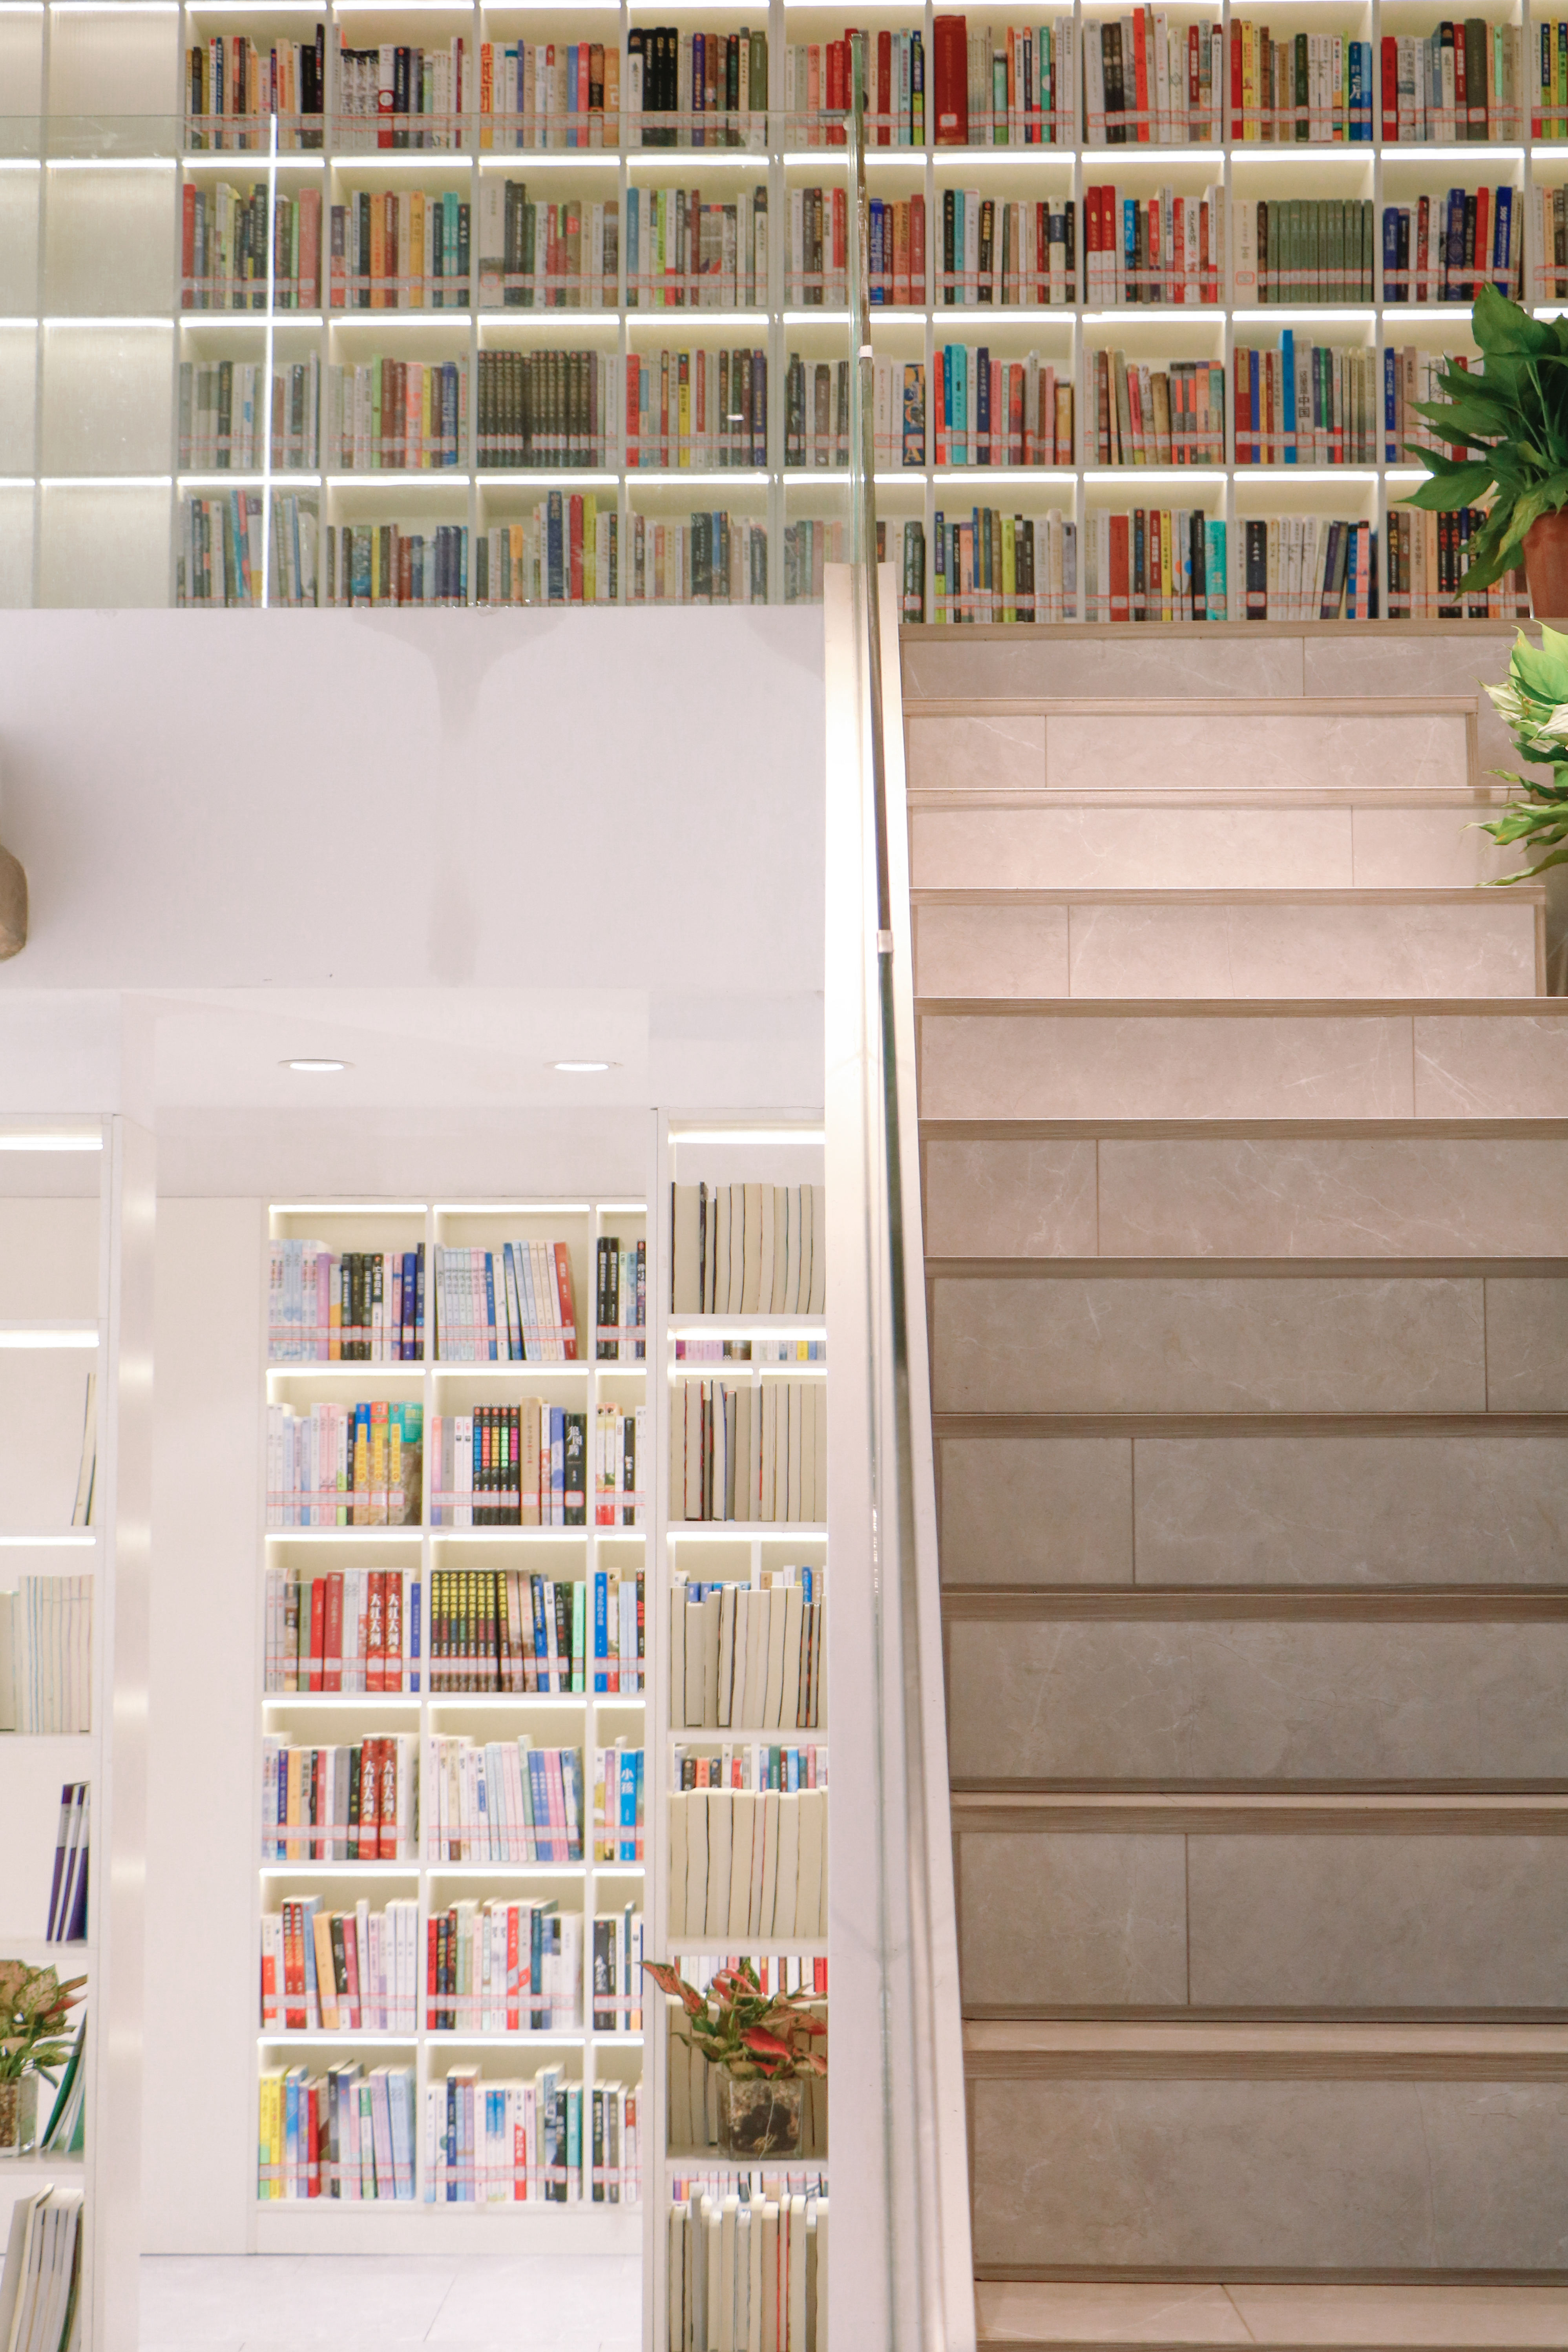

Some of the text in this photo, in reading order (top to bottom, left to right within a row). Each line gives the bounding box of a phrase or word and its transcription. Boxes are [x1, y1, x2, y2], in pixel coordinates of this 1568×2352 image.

[1298, 370, 1310, 418] 这里是中国
[566, 1425, 583, 1457] 狼图腾
[369, 1593, 382, 1646] 大江大河
[387, 1593, 400, 1646] 大江大河
[363, 1760, 374, 1814] 大江大河
[383, 1760, 395, 1814] 大江大河
[620, 1767, 634, 1794] 小孩
